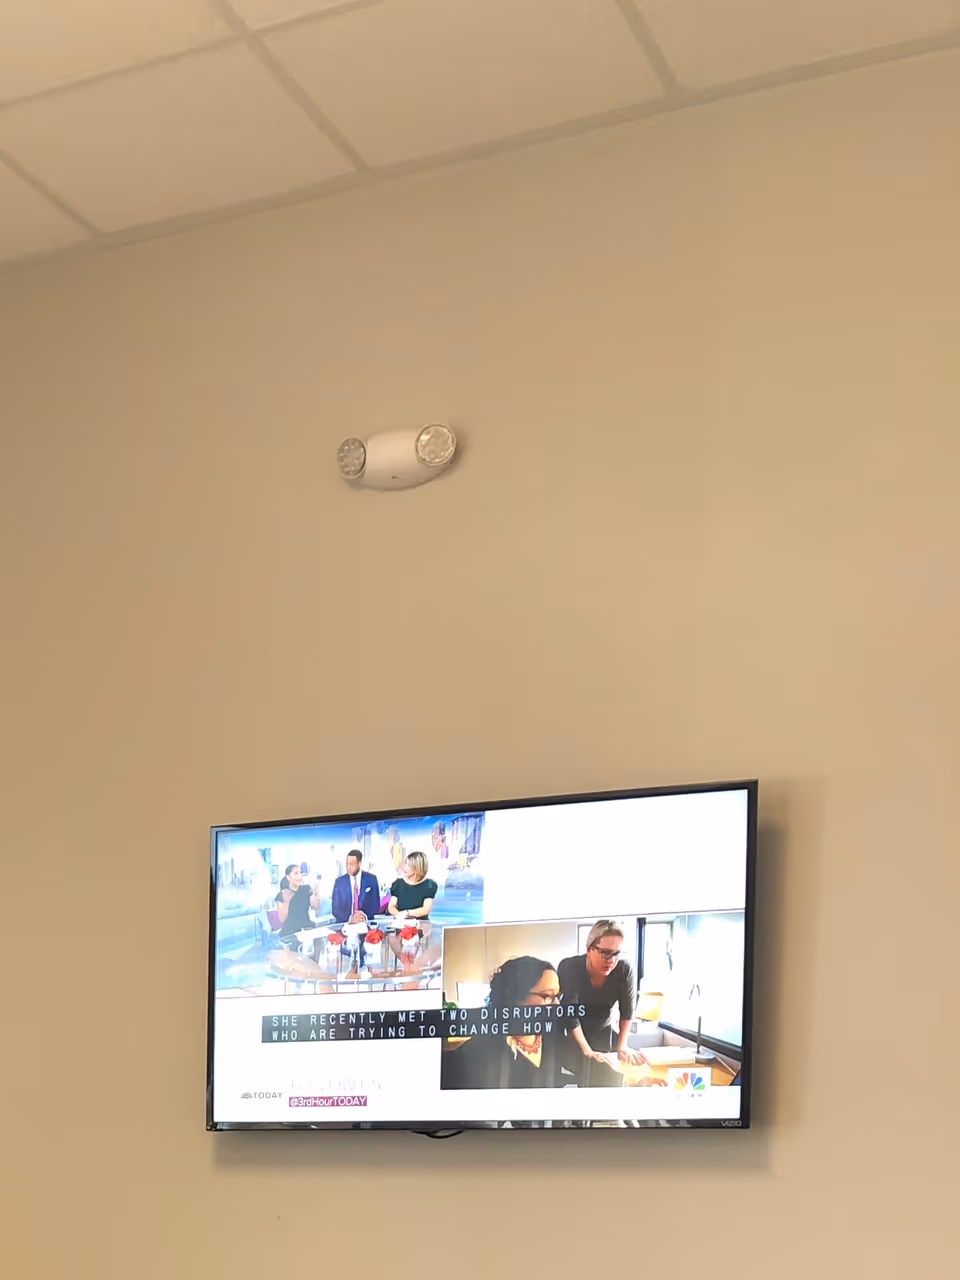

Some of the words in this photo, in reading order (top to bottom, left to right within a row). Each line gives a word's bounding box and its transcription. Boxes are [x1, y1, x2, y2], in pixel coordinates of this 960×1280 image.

[272, 1015, 298, 1027] SHE
[310, 1012, 386, 1025] RECENTLY
[398, 1010, 426, 1023] MET
[440, 1009, 468, 1021] TWO
[481, 1005, 586, 1020] DISRUPTORS
[272, 1029, 298, 1041] WHO
[309, 1028, 336, 1040] ARE
[349, 1026, 406, 1039] TRYING
[419, 1025, 436, 1036] TO
[449, 1023, 509, 1036] CHANGE
[523, 1021, 553, 1033] HOW
[253, 1091, 283, 1099] TODAY
[289, 1096, 367, 1107] @3rdHourTODAY
